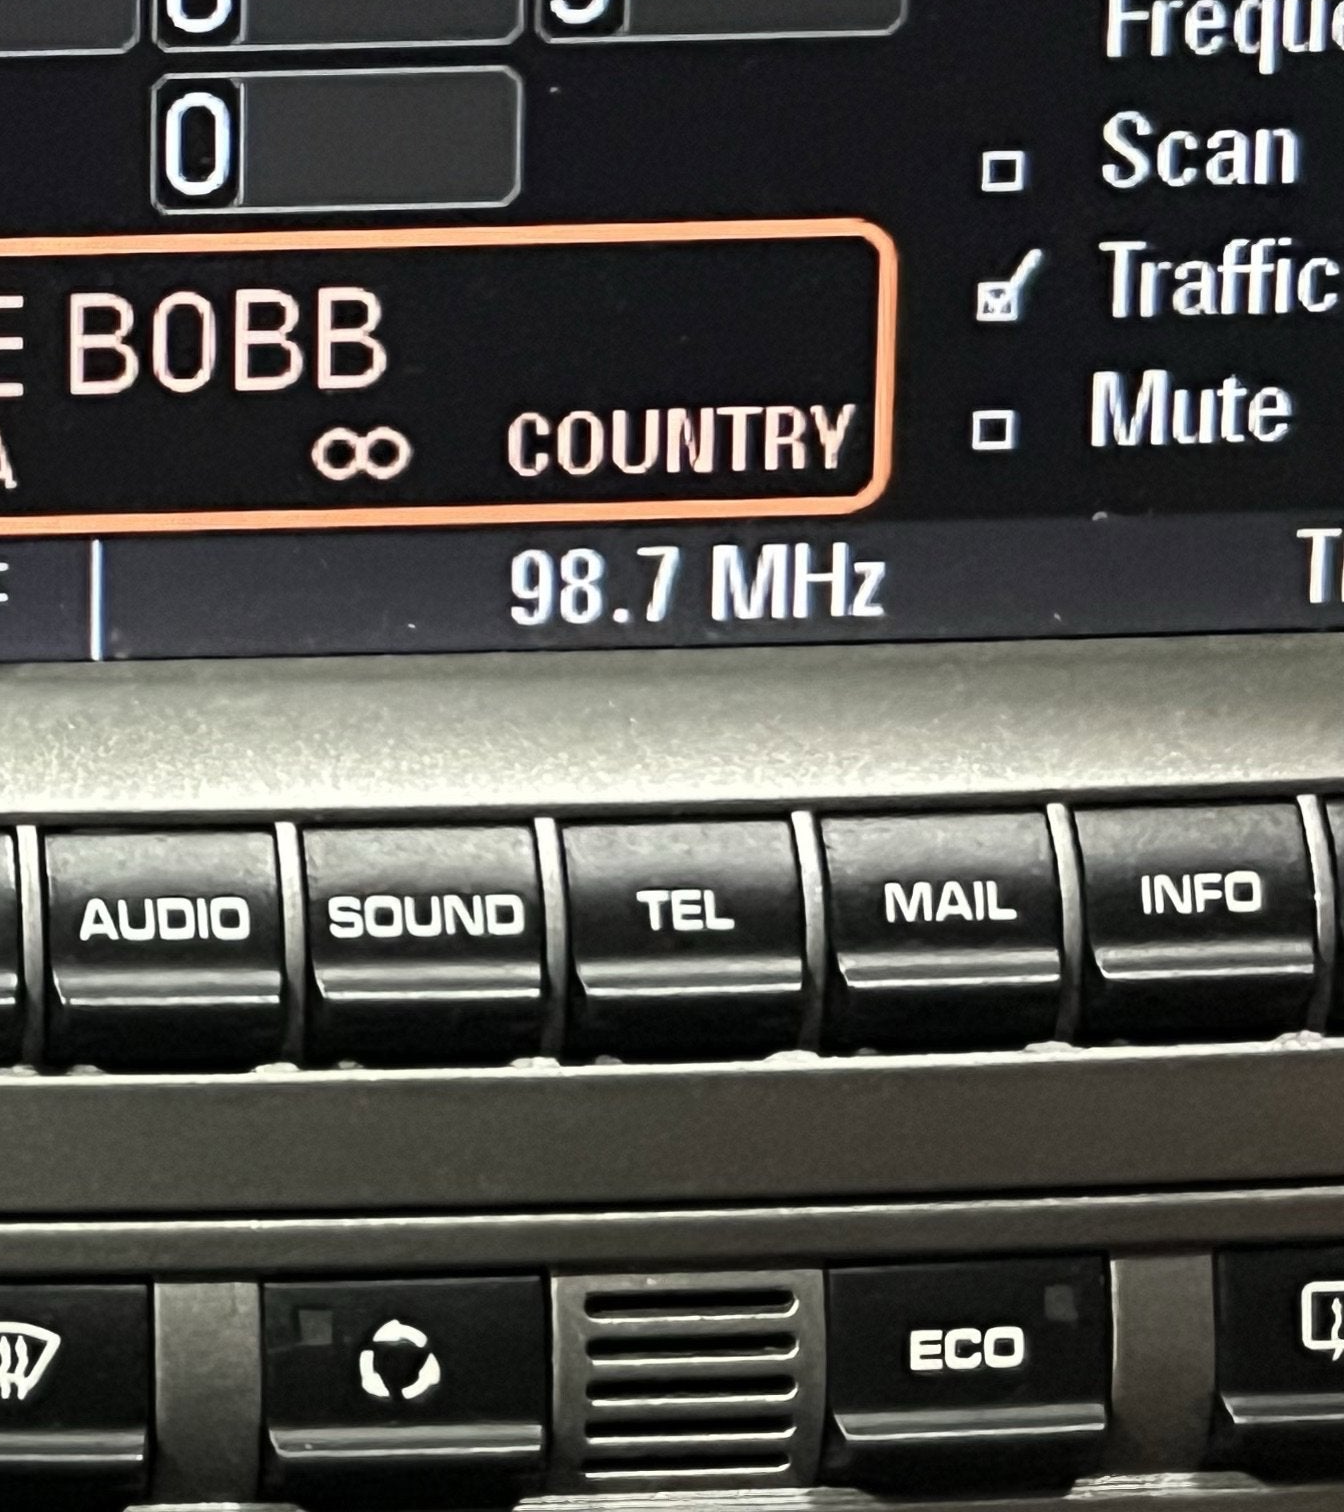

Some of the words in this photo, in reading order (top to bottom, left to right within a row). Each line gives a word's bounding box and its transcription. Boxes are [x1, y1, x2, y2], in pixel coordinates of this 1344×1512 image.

[165, 91, 231, 196] 0
[1101, 110, 1299, 189] Scan
[1098, 237, 1340, 319] Traffic
[69, 286, 387, 395] BOBB
[507, 403, 856, 477] COUNTRY
[1091, 369, 1292, 447] Mute
[510, 546, 680, 626] 98.7
[711, 541, 886, 622] MHz
[79, 896, 251, 941] AUDIO
[328, 894, 525, 939] SOUND
[635, 889, 735, 931] TEL
[884, 880, 1018, 923] MAIL
[1141, 870, 1263, 915] INFO
[909, 1326, 1025, 1371] ECO
